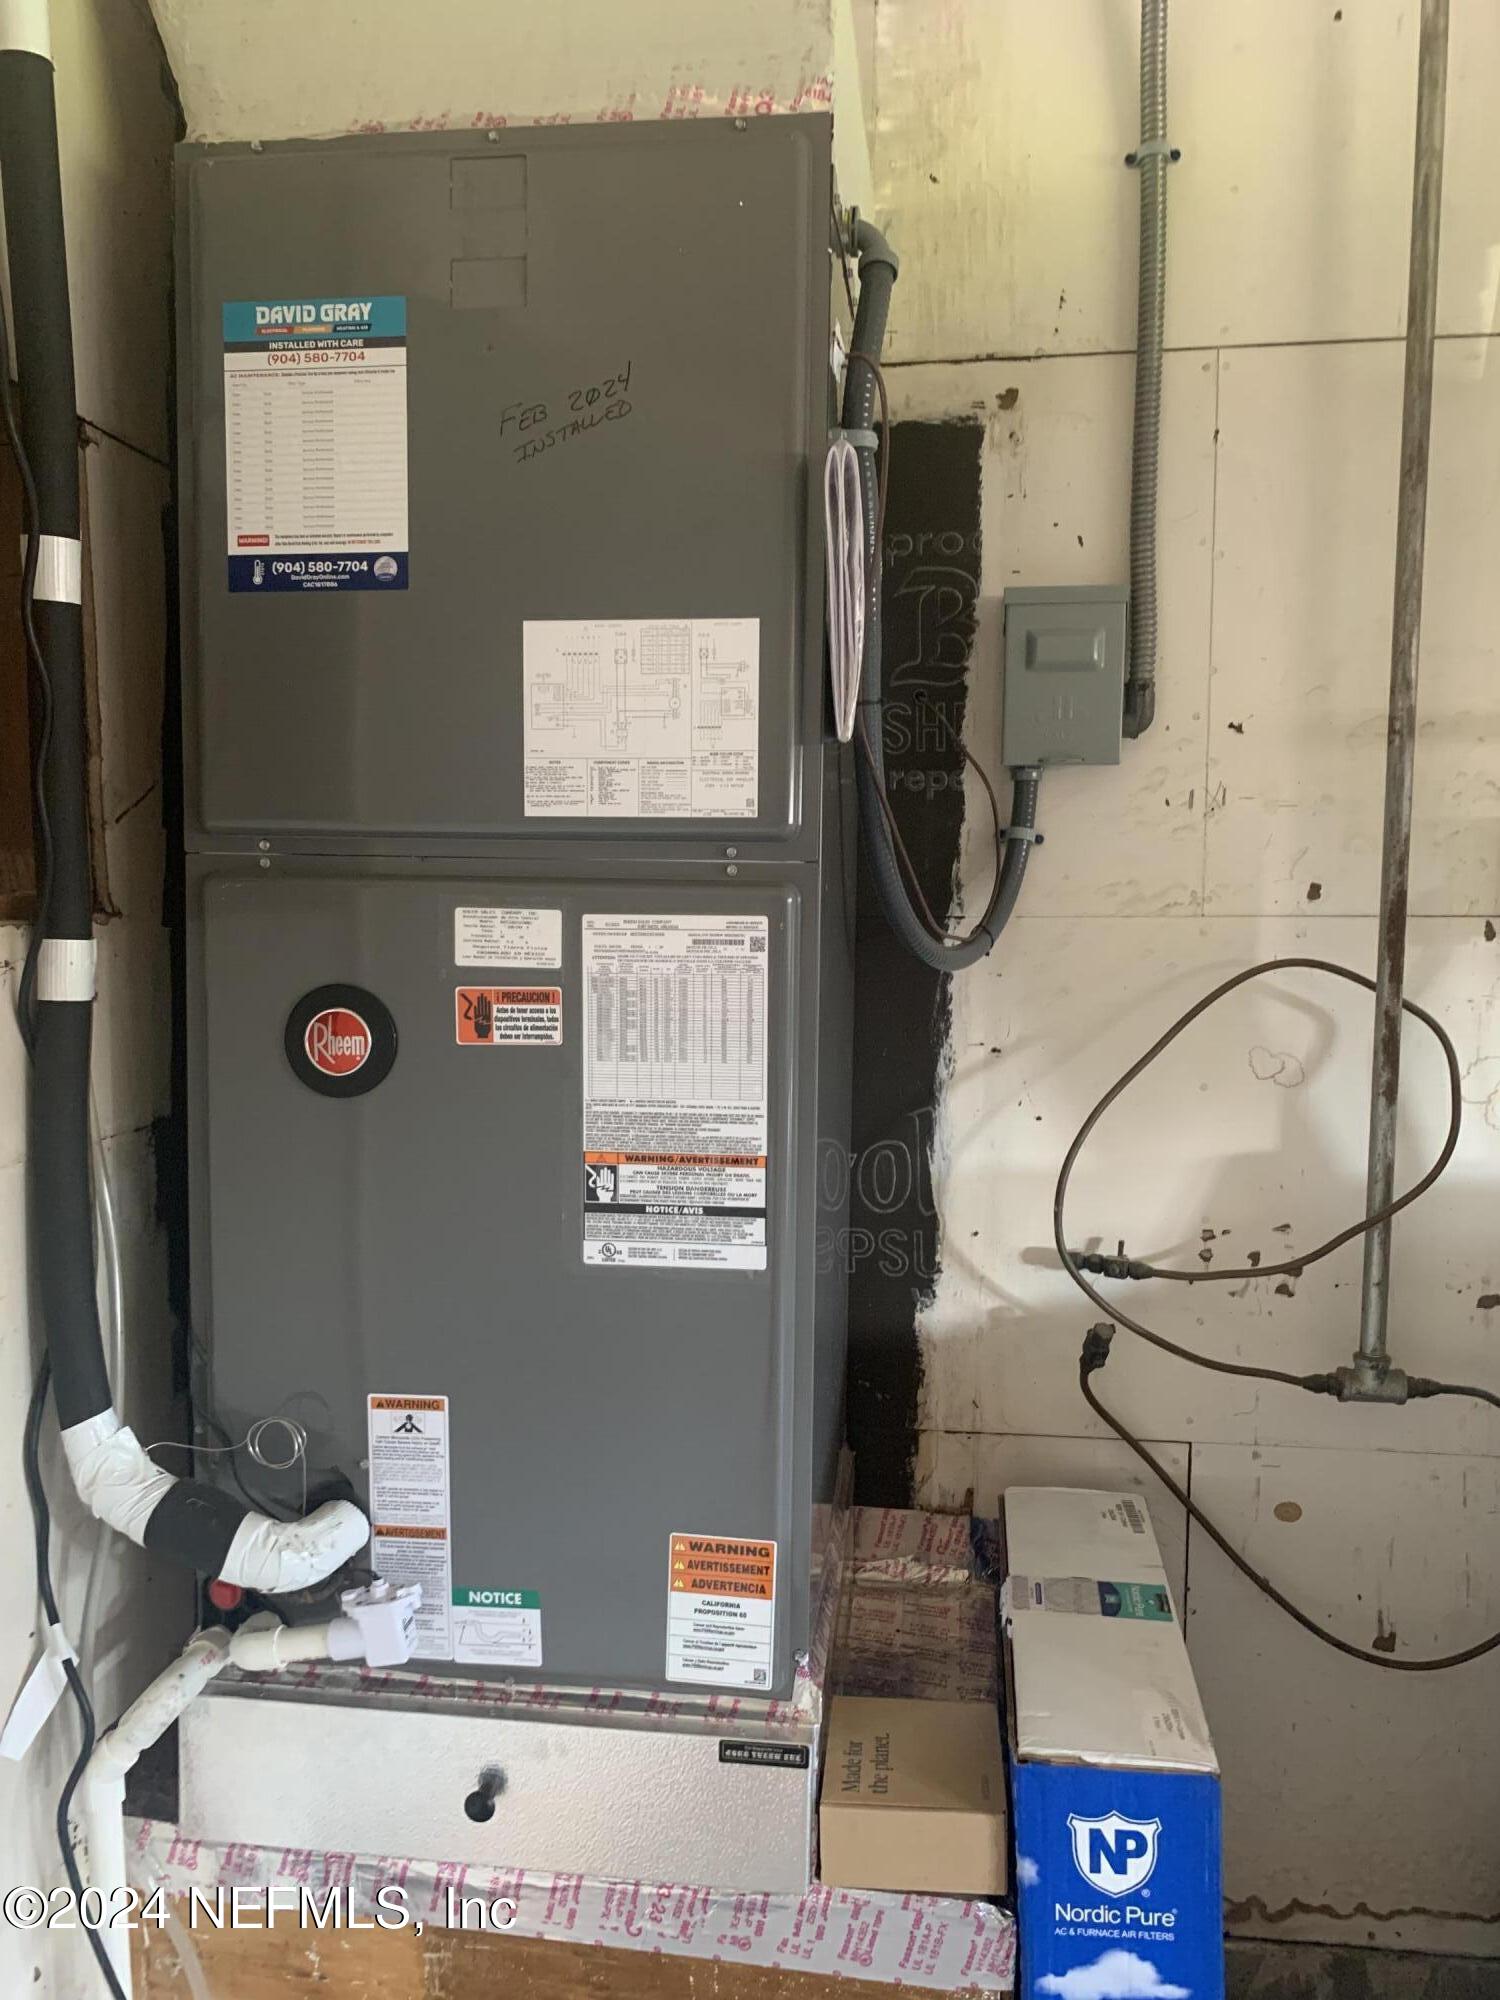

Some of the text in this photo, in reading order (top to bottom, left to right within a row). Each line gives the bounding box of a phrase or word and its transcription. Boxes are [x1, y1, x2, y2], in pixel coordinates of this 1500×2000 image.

[256, 302, 373, 324] DAVID GRAY
[269, 339, 364, 350] INSTALLED WITH CARE
[267, 351, 365, 366] (904) 580-7704
[500, 360, 631, 437] FEB 2024
[513, 400, 632, 463] INSTALLED
[272, 562, 305, 575] (904)
[308, 560, 368, 573] 580-7704
[313, 1014, 366, 1064] Rheem
[645, 1205, 704, 1215] NOTICE/AVIS
[386, 1400, 440, 1410] WARNING
[690, 1541, 770, 1558] WARNING
[688, 1560, 770, 1576] AVERTISSEMENT
[691, 1578, 766, 1594] ADVERTENCIA
[468, 1591, 522, 1605] NOTICE
[702, 1600, 741, 1609] CALIFORNIA
[694, 1608, 738, 1618] PROPOSITION
[842, 1740, 863, 1792] Made for
[869, 1772, 889, 1794] the
[1089, 1828, 1148, 1875] NP
[1055, 1903, 1175, 1926] Nordic Pure
[1054, 1927, 1174, 1941] AC & FURNACE AIR FILTERS
